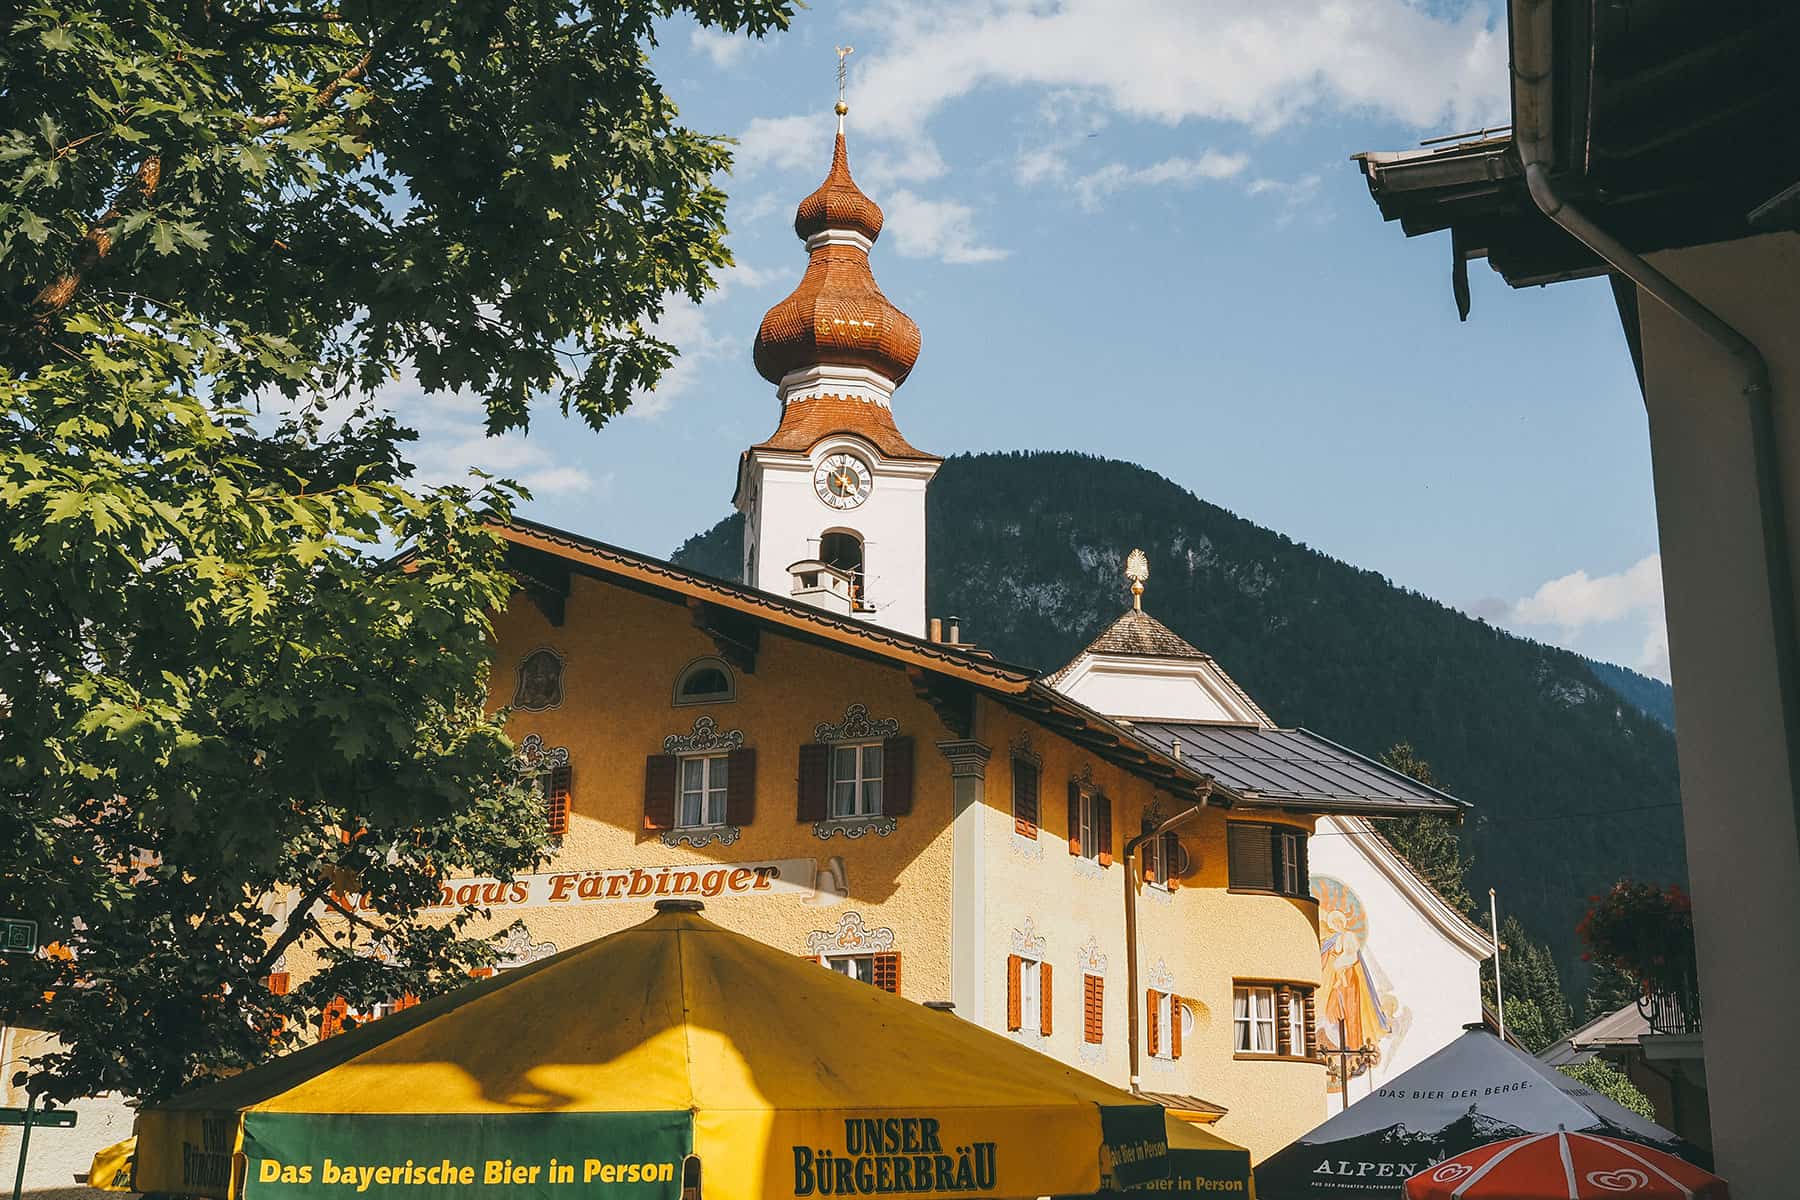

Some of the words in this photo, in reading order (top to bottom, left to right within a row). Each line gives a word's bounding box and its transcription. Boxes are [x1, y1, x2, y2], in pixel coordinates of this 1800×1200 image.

[548, 866, 779, 902] Färbinger
[1379, 1089, 1405, 1099] DAS
[1413, 1090, 1444, 1100] BIER
[1451, 1089, 1478, 1099] DER
[1484, 1080, 1533, 1096] BERGE.
[844, 1117, 943, 1155] UNSER
[259, 1159, 312, 1183] Das
[322, 1158, 475, 1192] bayerische
[484, 1159, 541, 1184] Bier
[549, 1158, 574, 1183] in
[583, 1158, 674, 1183] Person
[1312, 1159, 1417, 1177] ALPEN
[1178, 1176, 1192, 1191] in
[1196, 1175, 1244, 1192] Person
